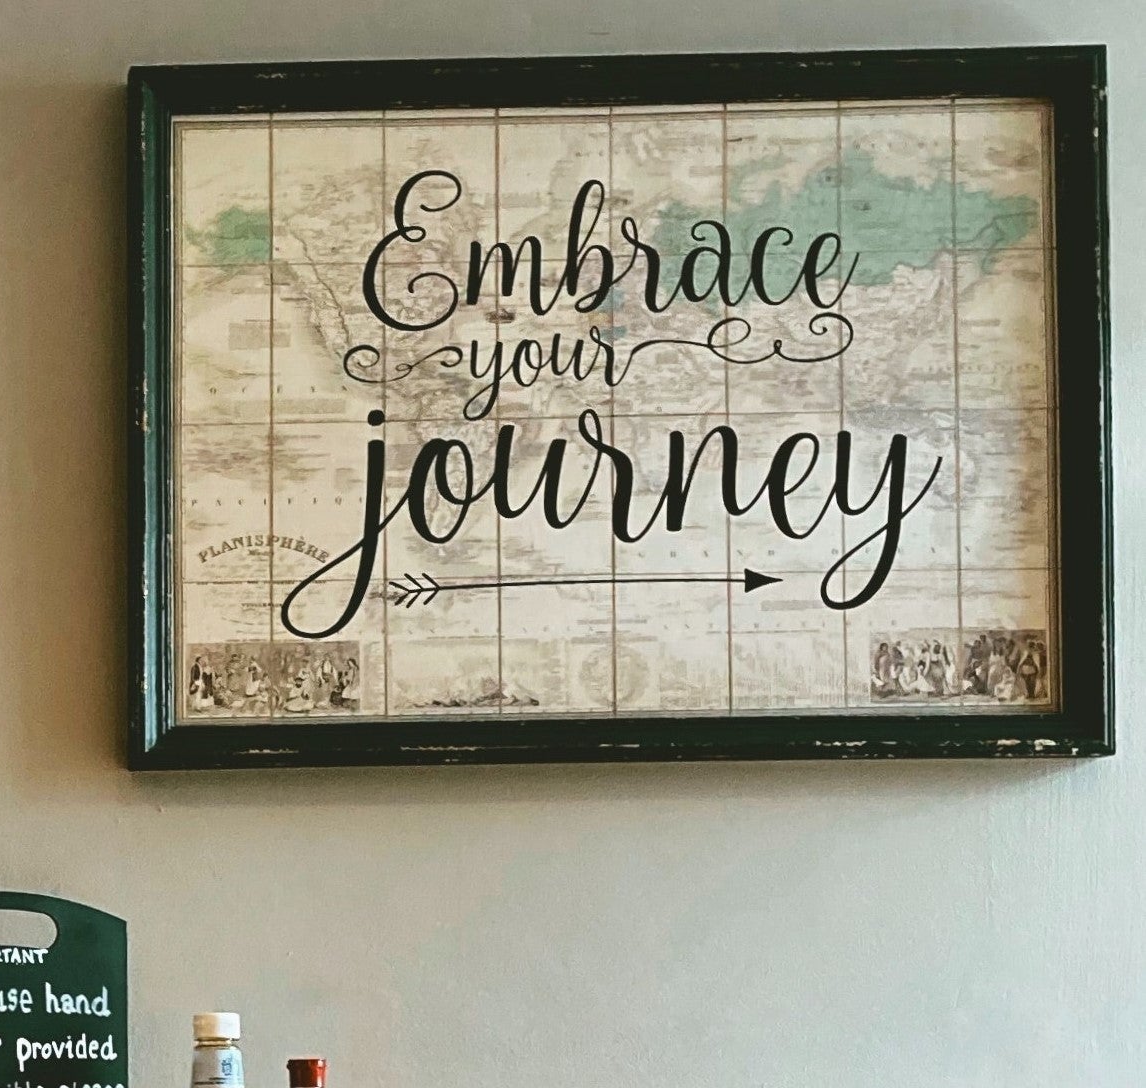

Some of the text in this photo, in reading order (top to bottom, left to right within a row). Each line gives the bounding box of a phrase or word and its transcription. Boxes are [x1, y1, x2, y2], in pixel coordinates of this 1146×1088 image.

[363, 169, 859, 332] Embrace
[463, 326, 629, 421] your
[198, 534, 330, 563] PLANISPHÈRE
[281, 409, 942, 639] journey
[45, 981, 111, 1018] hand
[16, 1033, 117, 1072] provided
